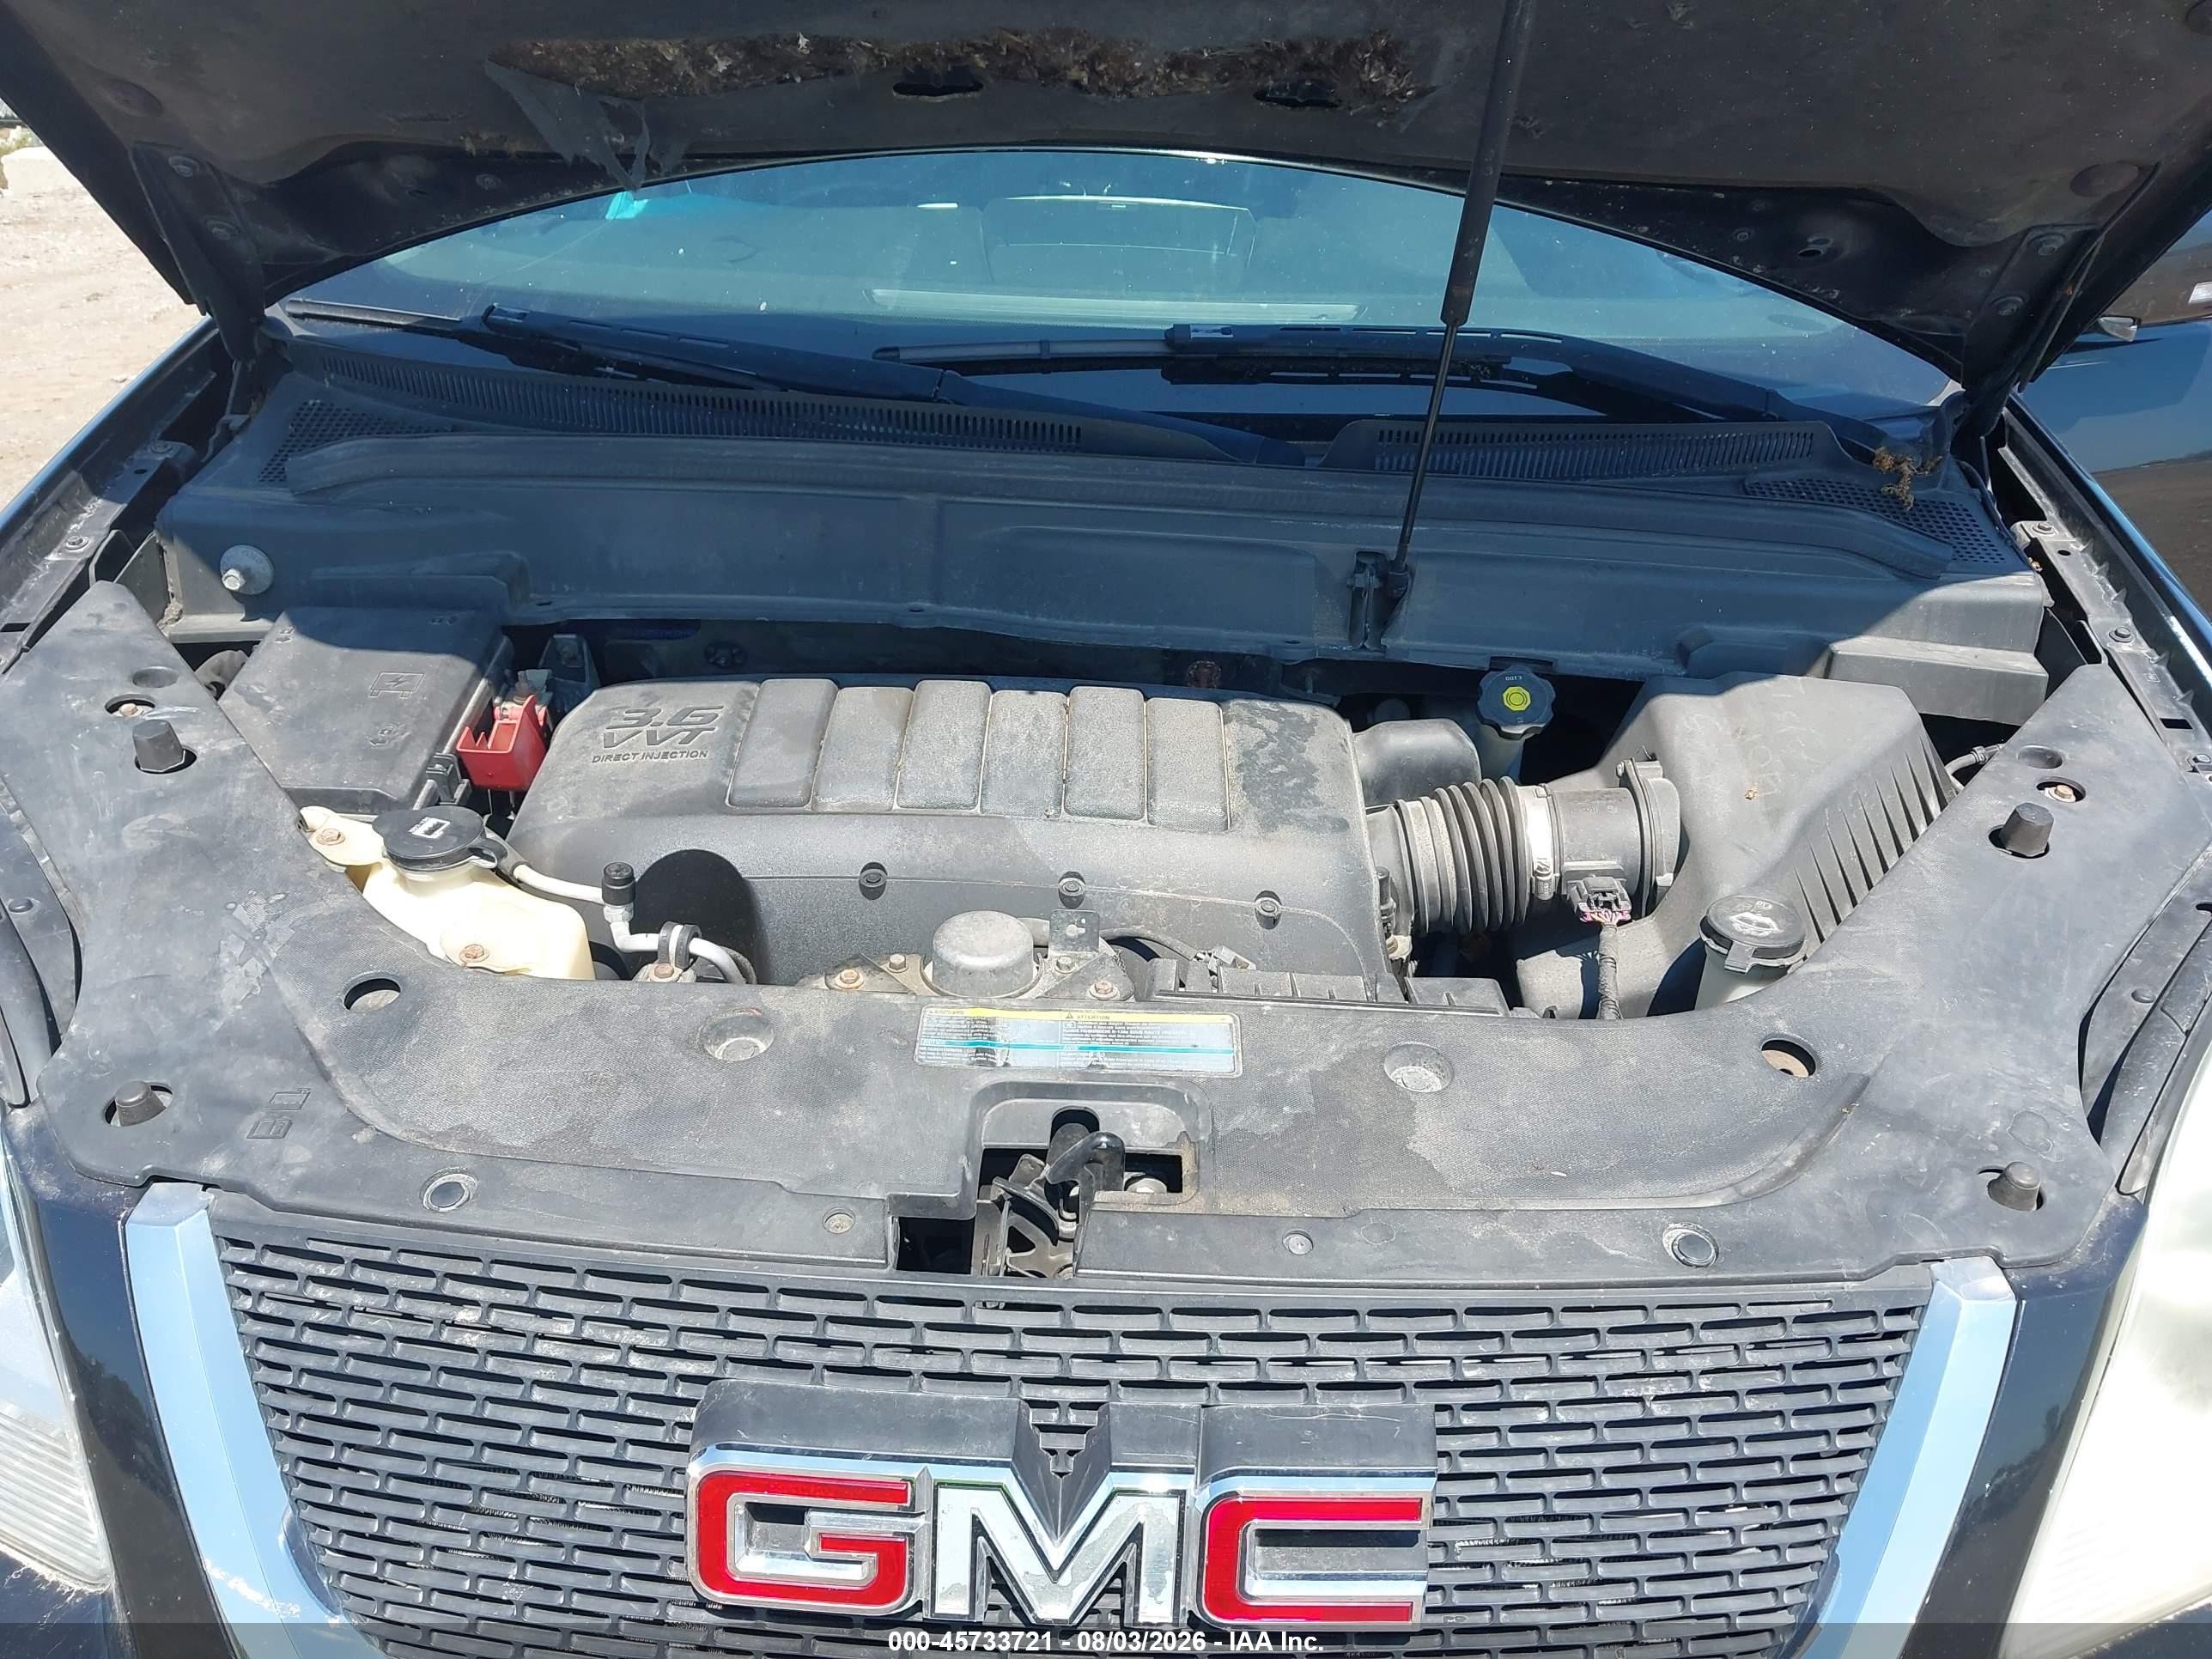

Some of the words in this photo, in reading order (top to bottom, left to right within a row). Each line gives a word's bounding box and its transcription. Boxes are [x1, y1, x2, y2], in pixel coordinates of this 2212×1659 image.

[605, 706, 724, 729] 3.6
[603, 726, 715, 748] VVT
[592, 752, 639, 763] DIRECT
[641, 750, 708, 760] INJECTION
[687, 1446, 1437, 1630] GMC
